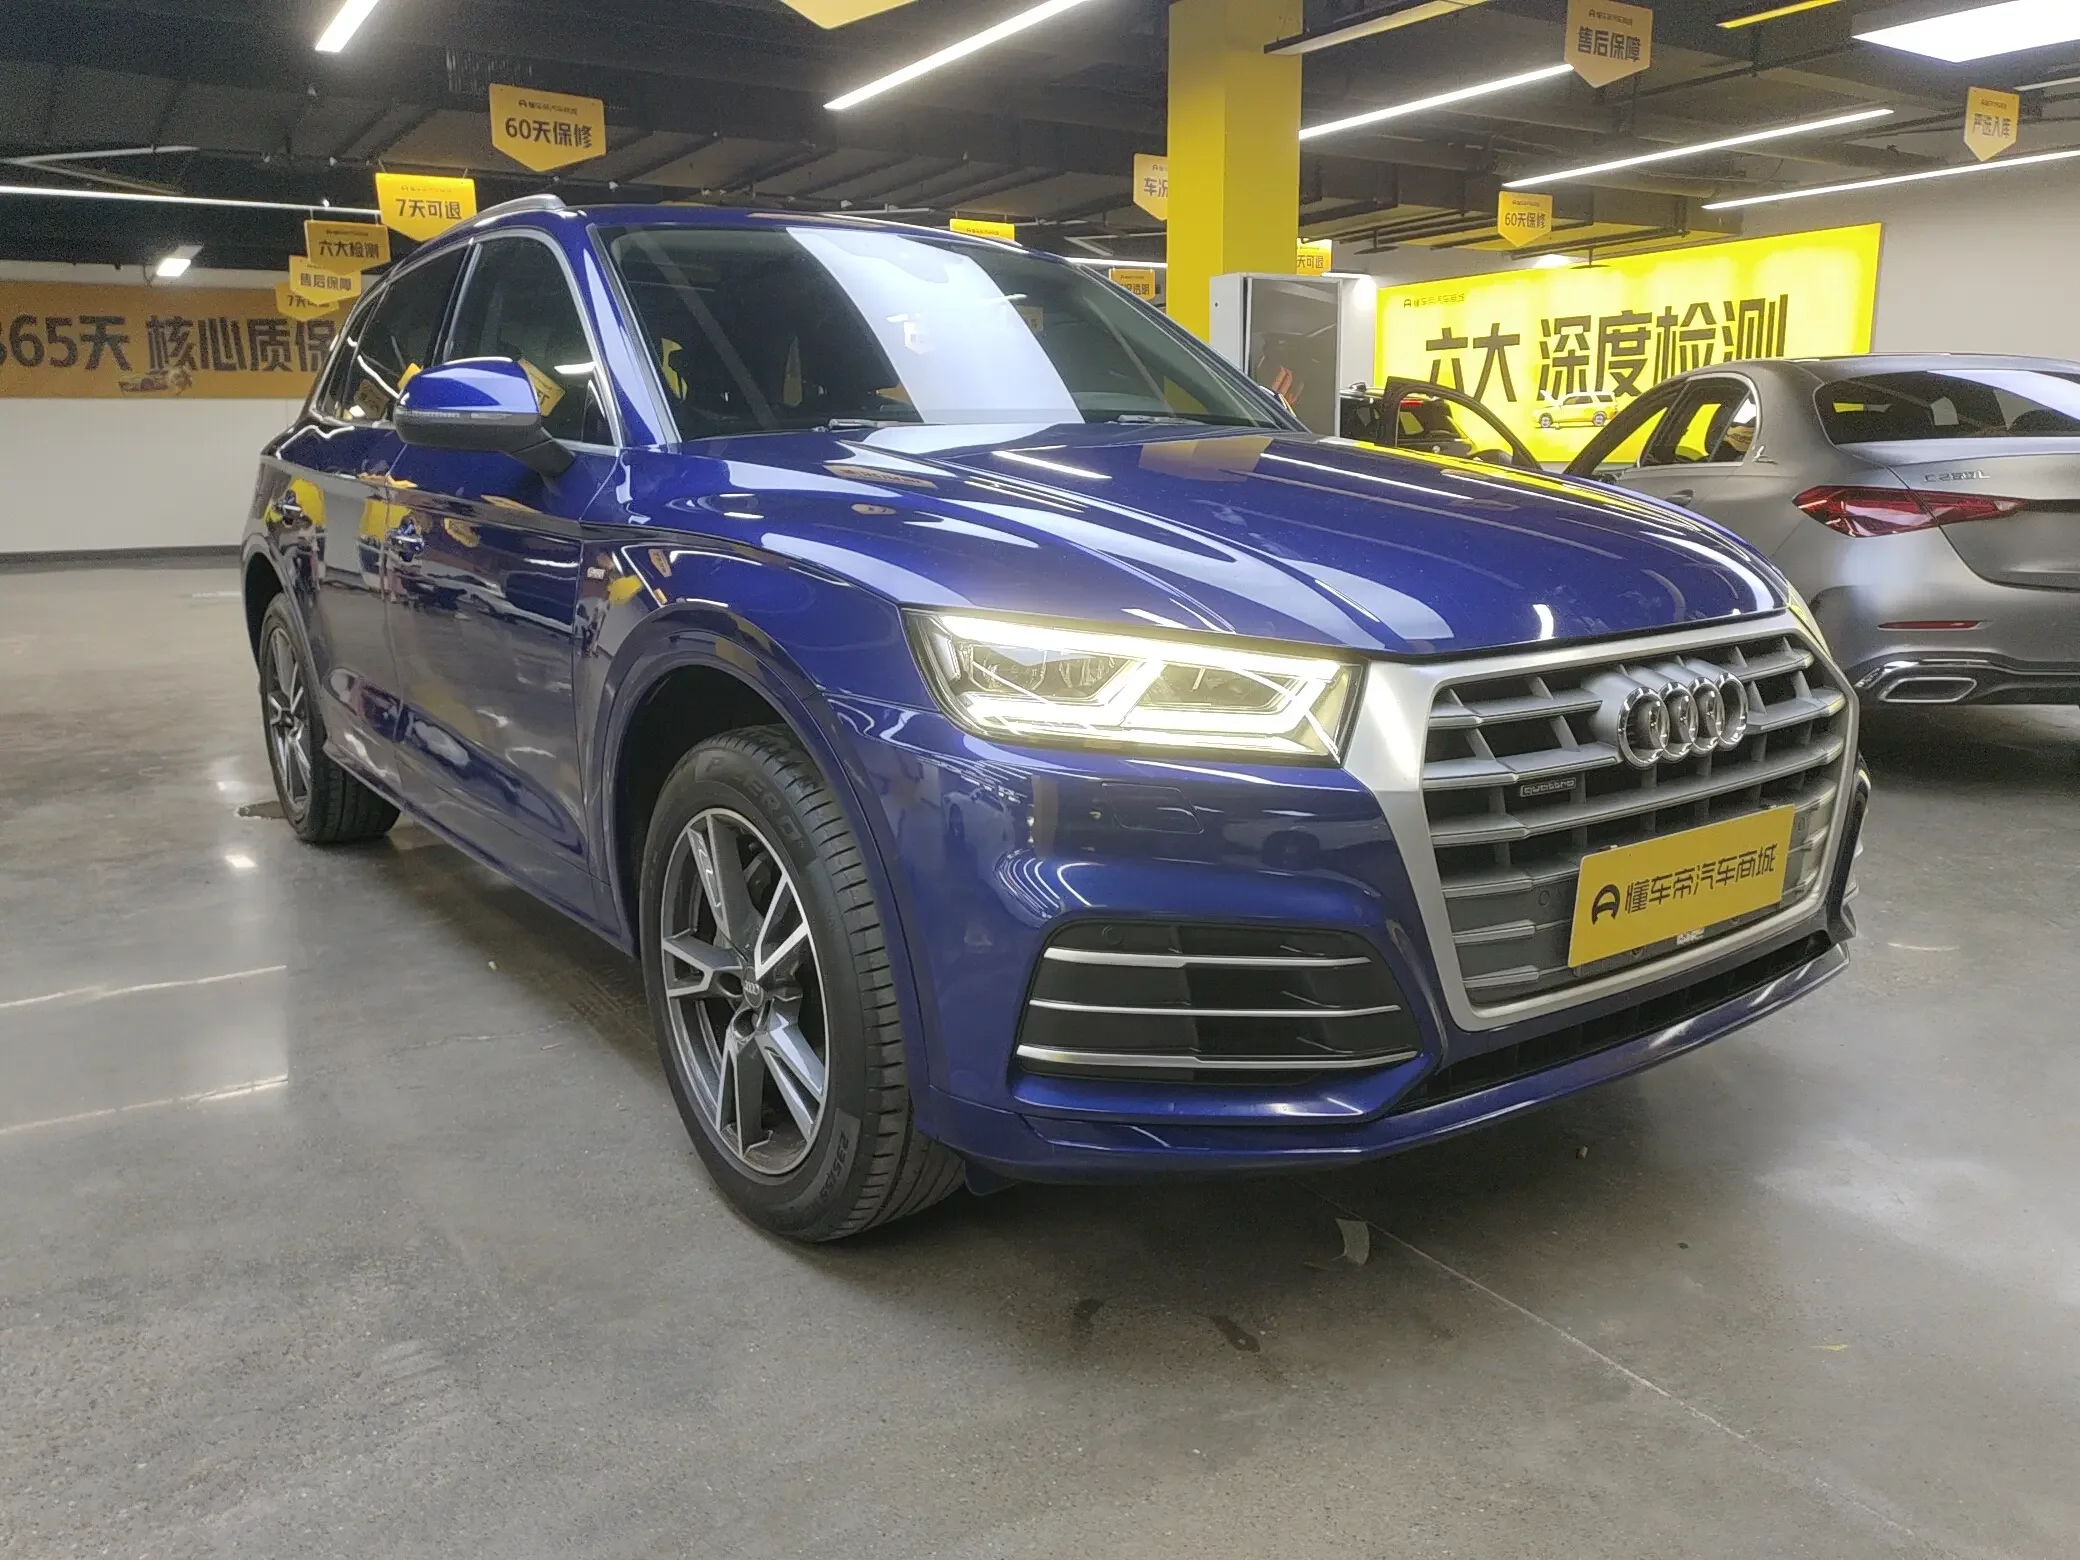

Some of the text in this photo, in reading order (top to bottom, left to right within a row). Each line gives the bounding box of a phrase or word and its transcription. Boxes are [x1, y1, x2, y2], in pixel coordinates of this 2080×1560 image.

[1578, 26, 1641, 62] 售后保障
[505, 117, 593, 148] 60天保修
[396, 198, 462, 219] 7天可退
[1504, 212, 1546, 229] 60天保修
[318, 240, 379, 259] 六大检测
[300, 273, 352, 291] 售后保障
[287, 294, 329, 308] 7天
[1425, 294, 1789, 402] 六大 深度检测
[1523, 779, 1575, 796] quattro
[1624, 843, 1779, 915] 懂车帝汽车商城
